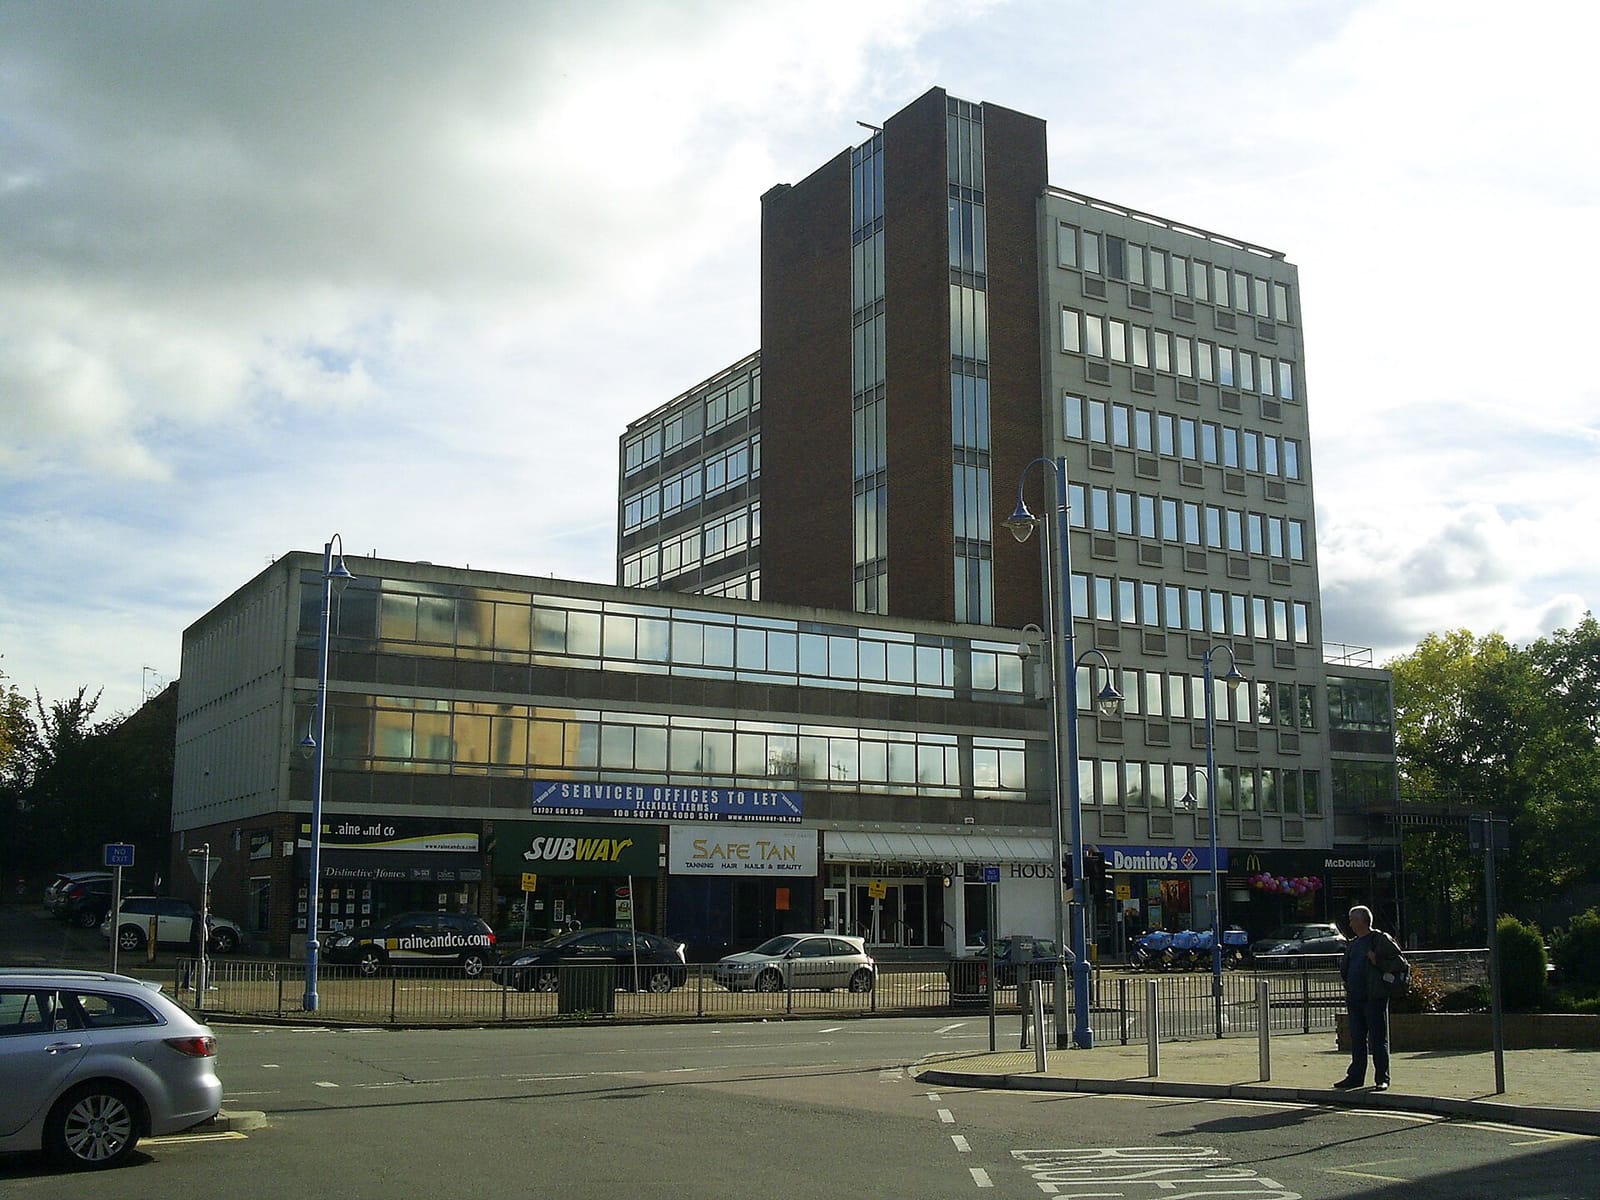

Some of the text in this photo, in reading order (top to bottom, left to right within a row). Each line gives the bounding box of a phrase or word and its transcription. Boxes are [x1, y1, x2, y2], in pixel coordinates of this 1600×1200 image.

[560, 783, 644, 801] SERVICED
[653, 787, 719, 804] OFFICES
[727, 791, 745, 805] TO
[753, 792, 778, 806] LET
[636, 801, 709, 812] FLEXIBLE TERMS
[613, 809, 629, 817] 100
[633, 810, 654, 818] SQFT
[672, 811, 695, 819] 4000
[698, 812, 719, 820] SQFT
[334, 822, 361, 836] aine
[383, 825, 395, 837] co
[524, 836, 633, 861] SUBWAY
[112, 855, 128, 863] EXIT
[1113, 850, 1178, 870] Domino's
[325, 866, 373, 878] Distinctive
[372, 867, 406, 880] Homes
[1010, 862, 1056, 878] HOUS
[399, 932, 491, 950] raineandco.com
